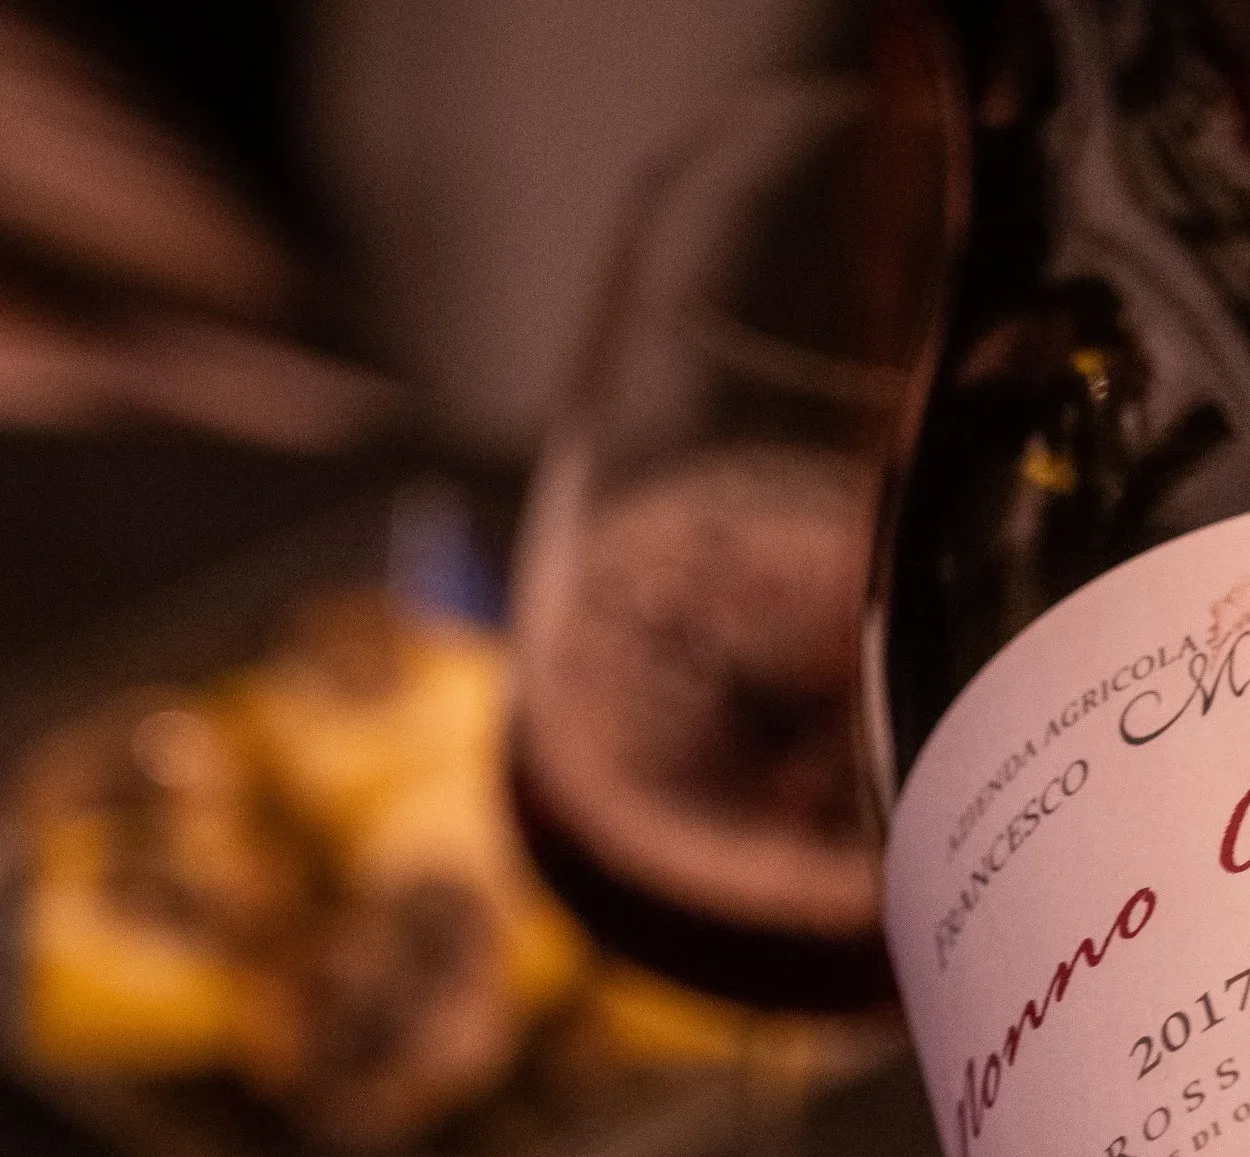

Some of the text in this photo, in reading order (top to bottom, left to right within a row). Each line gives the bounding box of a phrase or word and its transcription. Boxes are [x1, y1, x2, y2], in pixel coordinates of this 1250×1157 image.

[1040, 634, 1200, 746] AGRICOLA
[934, 757, 1090, 970] FRANCESCO
[1190, 1120, 1226, 1154] DI
